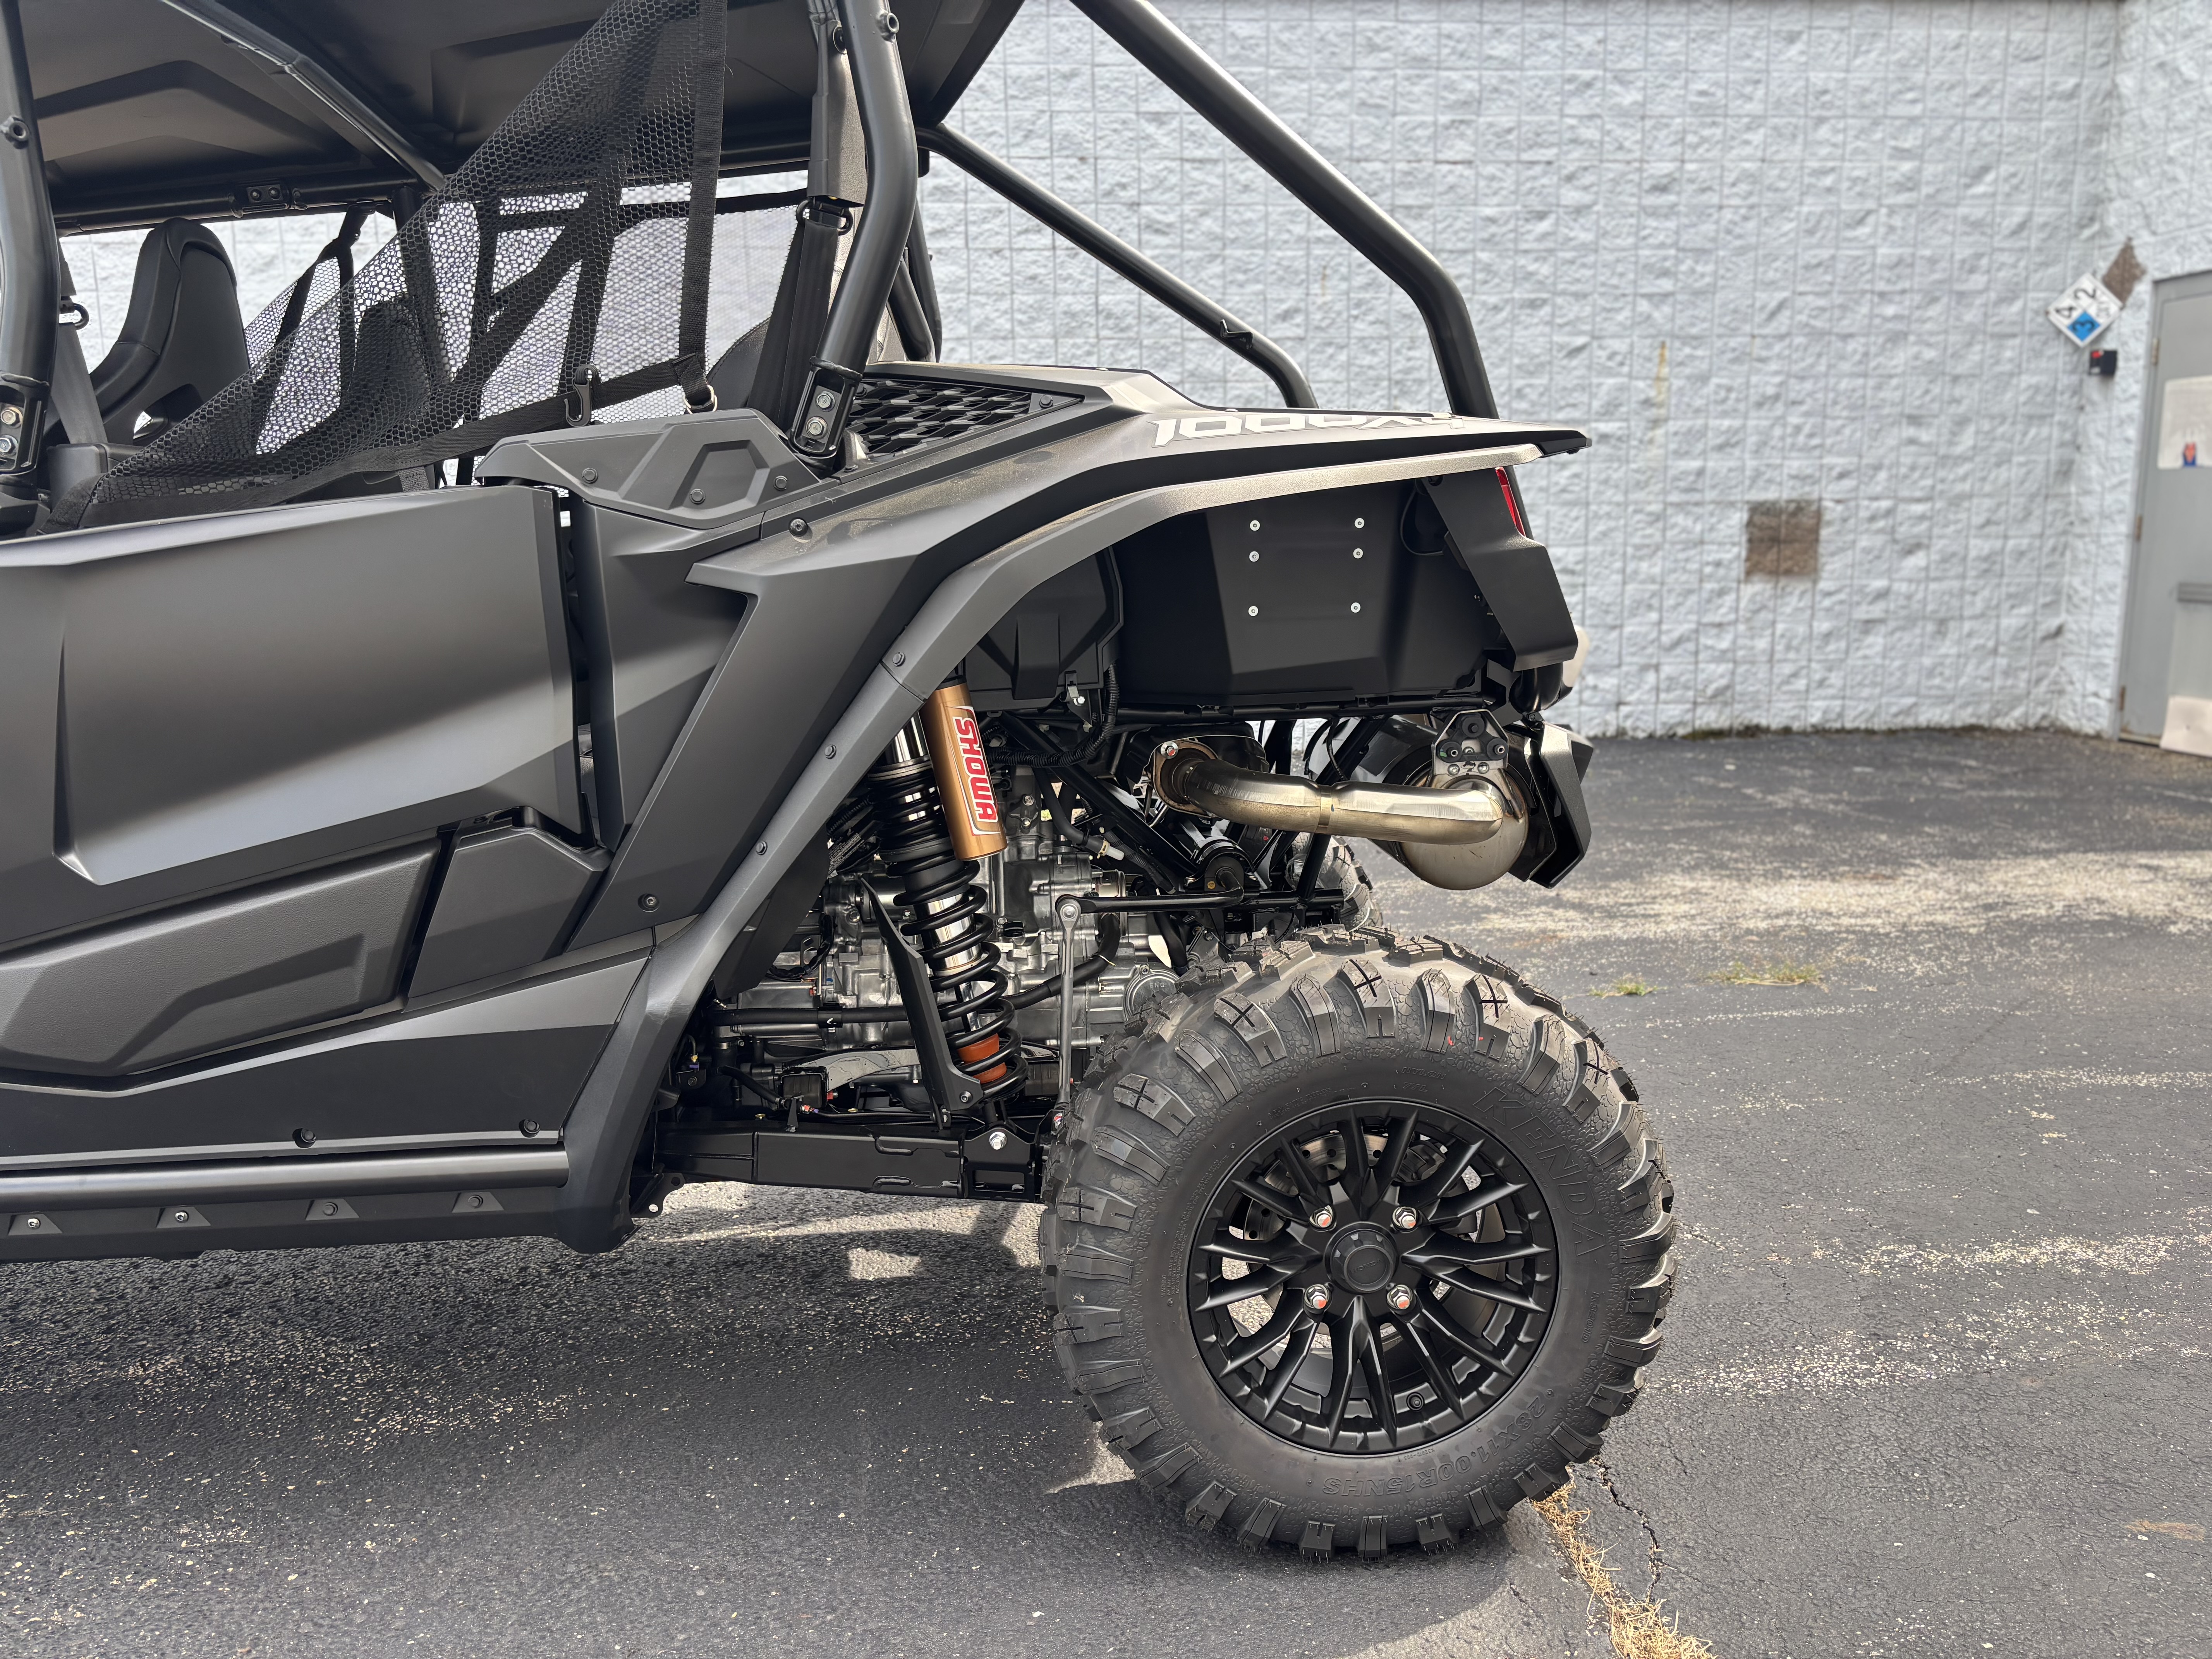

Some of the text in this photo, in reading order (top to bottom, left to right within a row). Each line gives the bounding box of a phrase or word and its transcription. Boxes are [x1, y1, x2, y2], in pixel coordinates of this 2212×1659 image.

[2073, 287, 2097, 299] 2
[2072, 320, 2096, 331] 3
[953, 716, 998, 823] SHOWA
[1401, 1066, 1446, 1079] NYLON
[1403, 1082, 1428, 1092] 77L
[1472, 1087, 1606, 1256] KENDA
[1350, 1257, 1382, 1274] HONDA
[1581, 1291, 1601, 1343] K3201D
[1322, 1396, 1546, 1496] 28X11.00R15NHS
